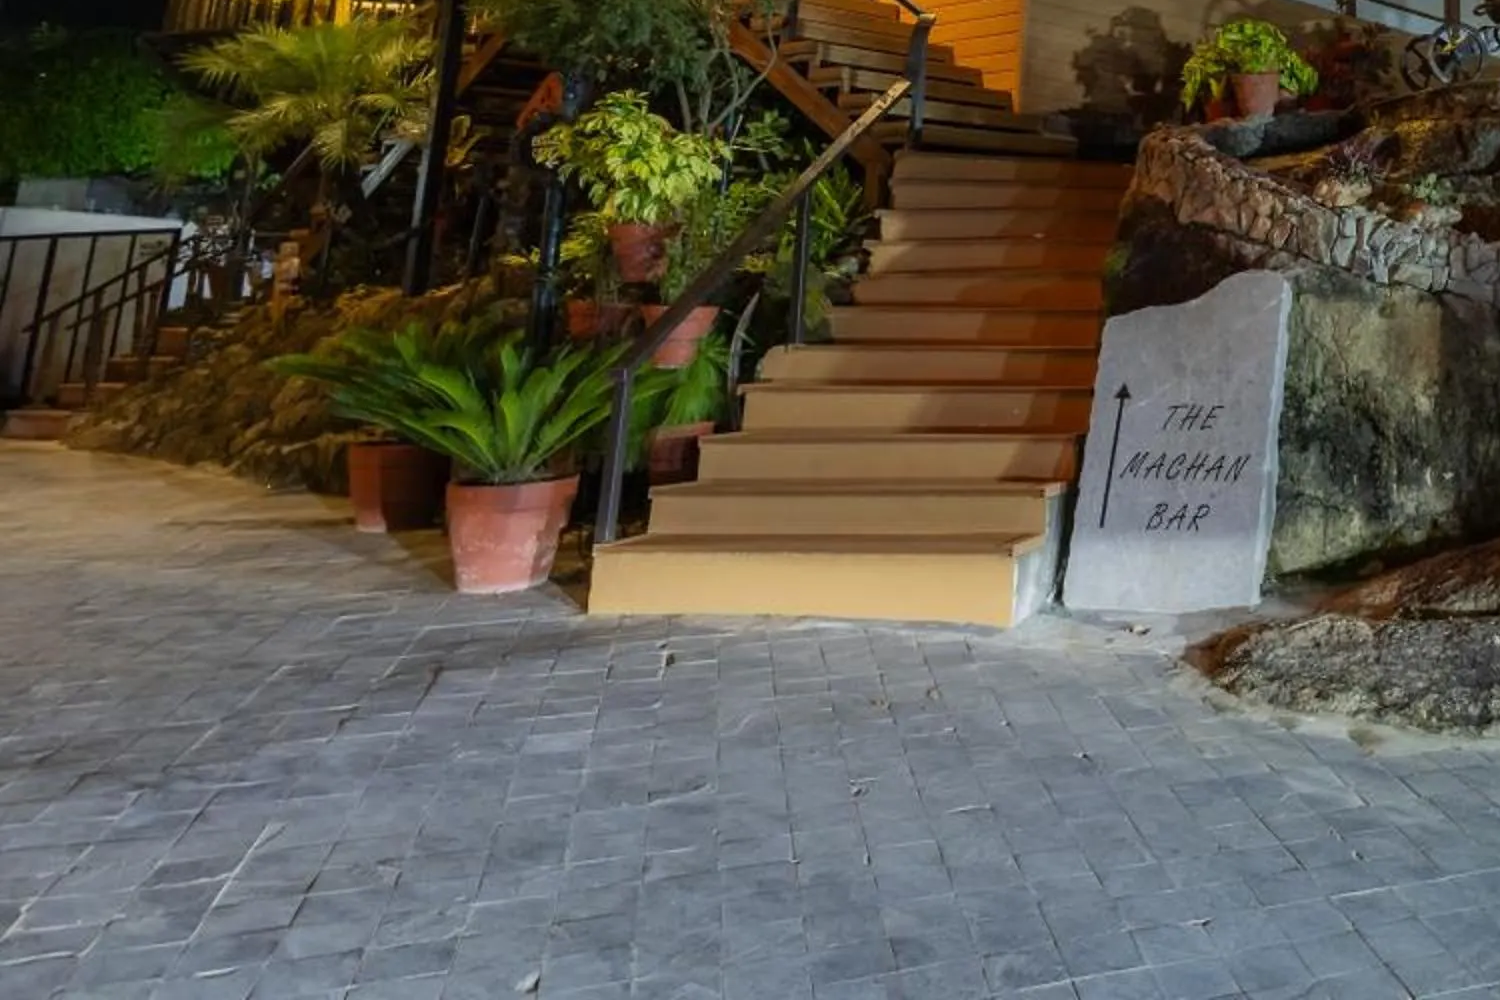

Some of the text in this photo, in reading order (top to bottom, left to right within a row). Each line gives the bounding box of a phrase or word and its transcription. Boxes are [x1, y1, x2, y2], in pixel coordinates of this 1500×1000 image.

[1161, 404, 1224, 432] THE
[1119, 450, 1251, 483] MACHAN
[1145, 502, 1212, 532] BAR
